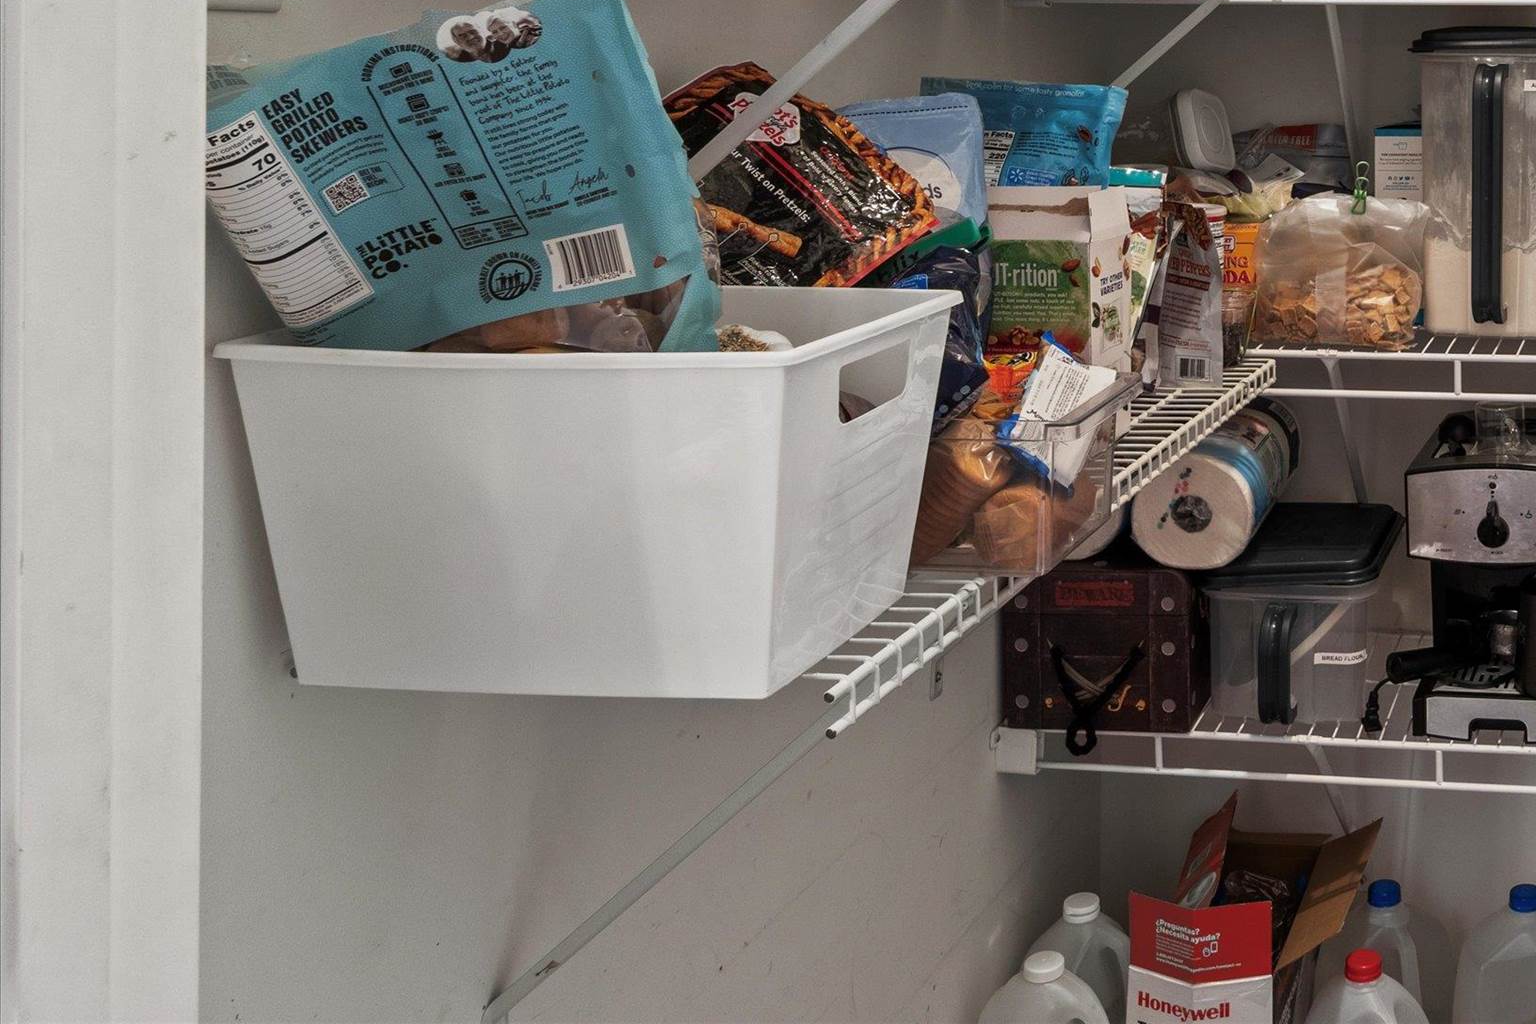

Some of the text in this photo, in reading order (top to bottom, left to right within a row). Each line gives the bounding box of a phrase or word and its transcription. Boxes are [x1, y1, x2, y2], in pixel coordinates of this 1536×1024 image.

[361, 44, 440, 82] COOKING INSTRUCTIONS
[261, 88, 303, 120] EASY
[270, 91, 335, 135] GRILLED
[478, 111, 513, 125] Company
[208, 120, 255, 146] Facts
[281, 107, 340, 150] POTATO
[220, 134, 254, 154] container
[290, 116, 369, 164] SKEWERS
[252, 153, 276, 171] 70
[741, 157, 811, 223] Twist on Pretzels:
[363, 232, 443, 270] POTATO
[371, 260, 408, 279] CO.
[1223, 256, 1249, 269] ING
[1101, 272, 1123, 285] TRY OTHER
[1101, 281, 1123, 297] VARIETIES
[1344, 654, 1363, 662] FLOUR
[1156, 919, 1200, 935] ¿Preguntas?
[1156, 927, 1221, 944] ¿Necesita ayuda?
[1138, 990, 1231, 1022] Honeywell
